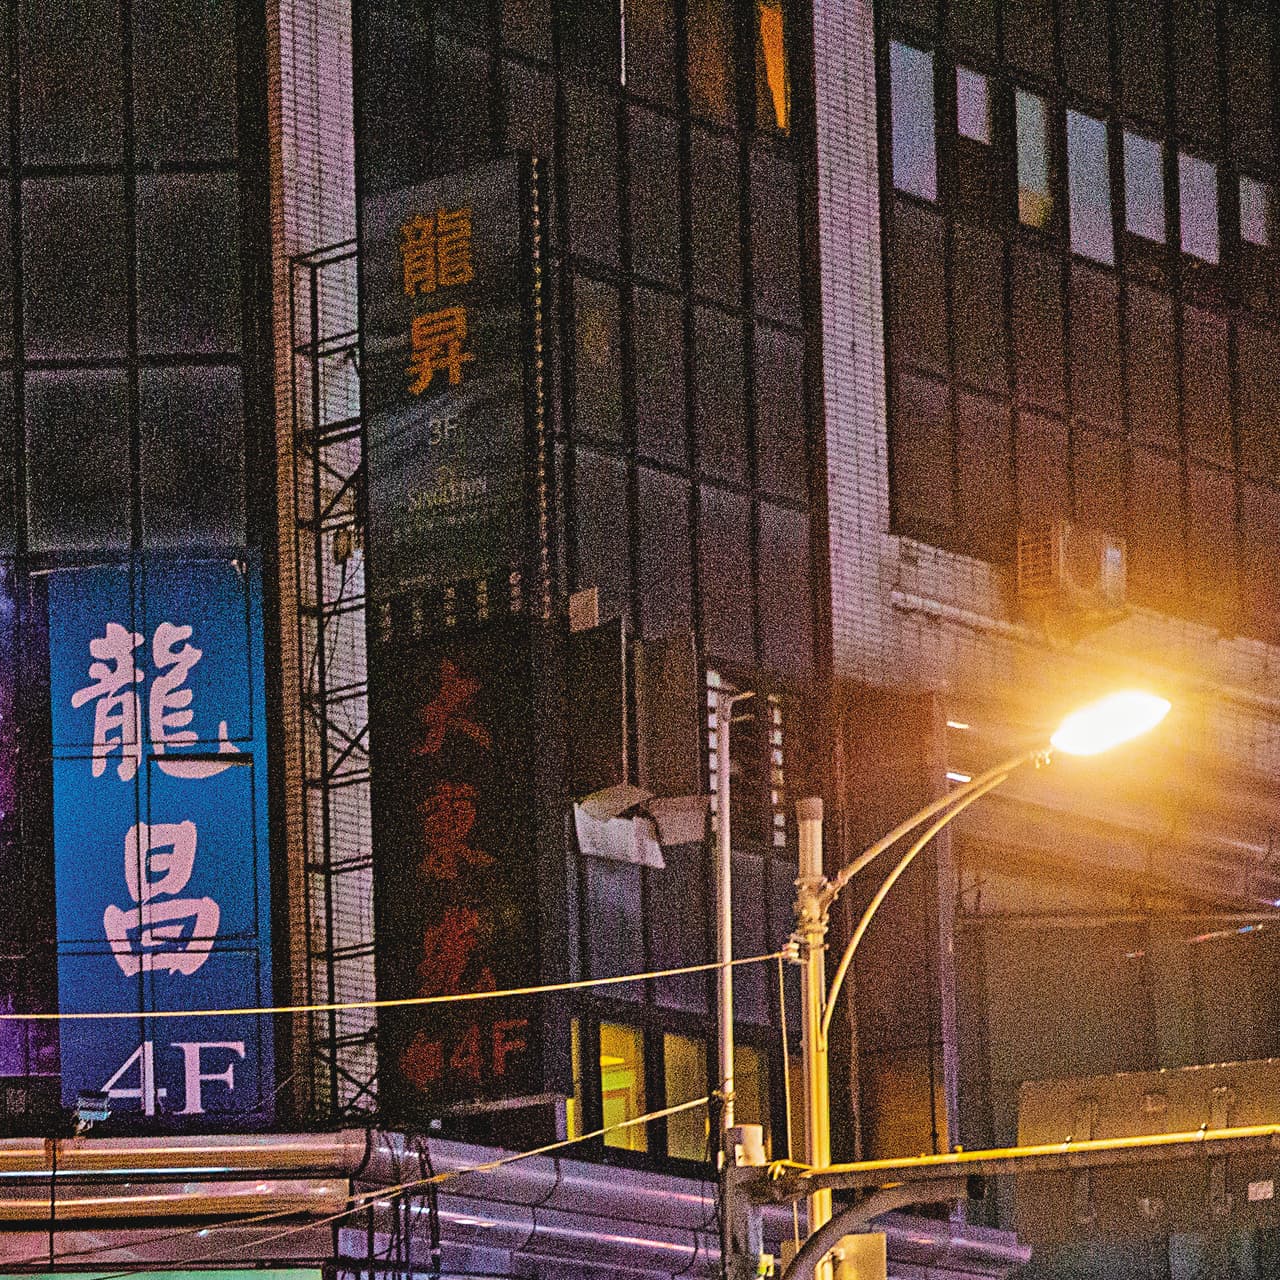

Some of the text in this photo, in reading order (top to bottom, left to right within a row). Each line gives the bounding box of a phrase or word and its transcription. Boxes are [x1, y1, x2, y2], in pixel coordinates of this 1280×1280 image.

[401, 207, 474, 395] 龍昇
[70, 621, 240, 976] 龍昌
[100, 1040, 246, 1116] 4F
[450, 1018, 528, 1078] 4F
